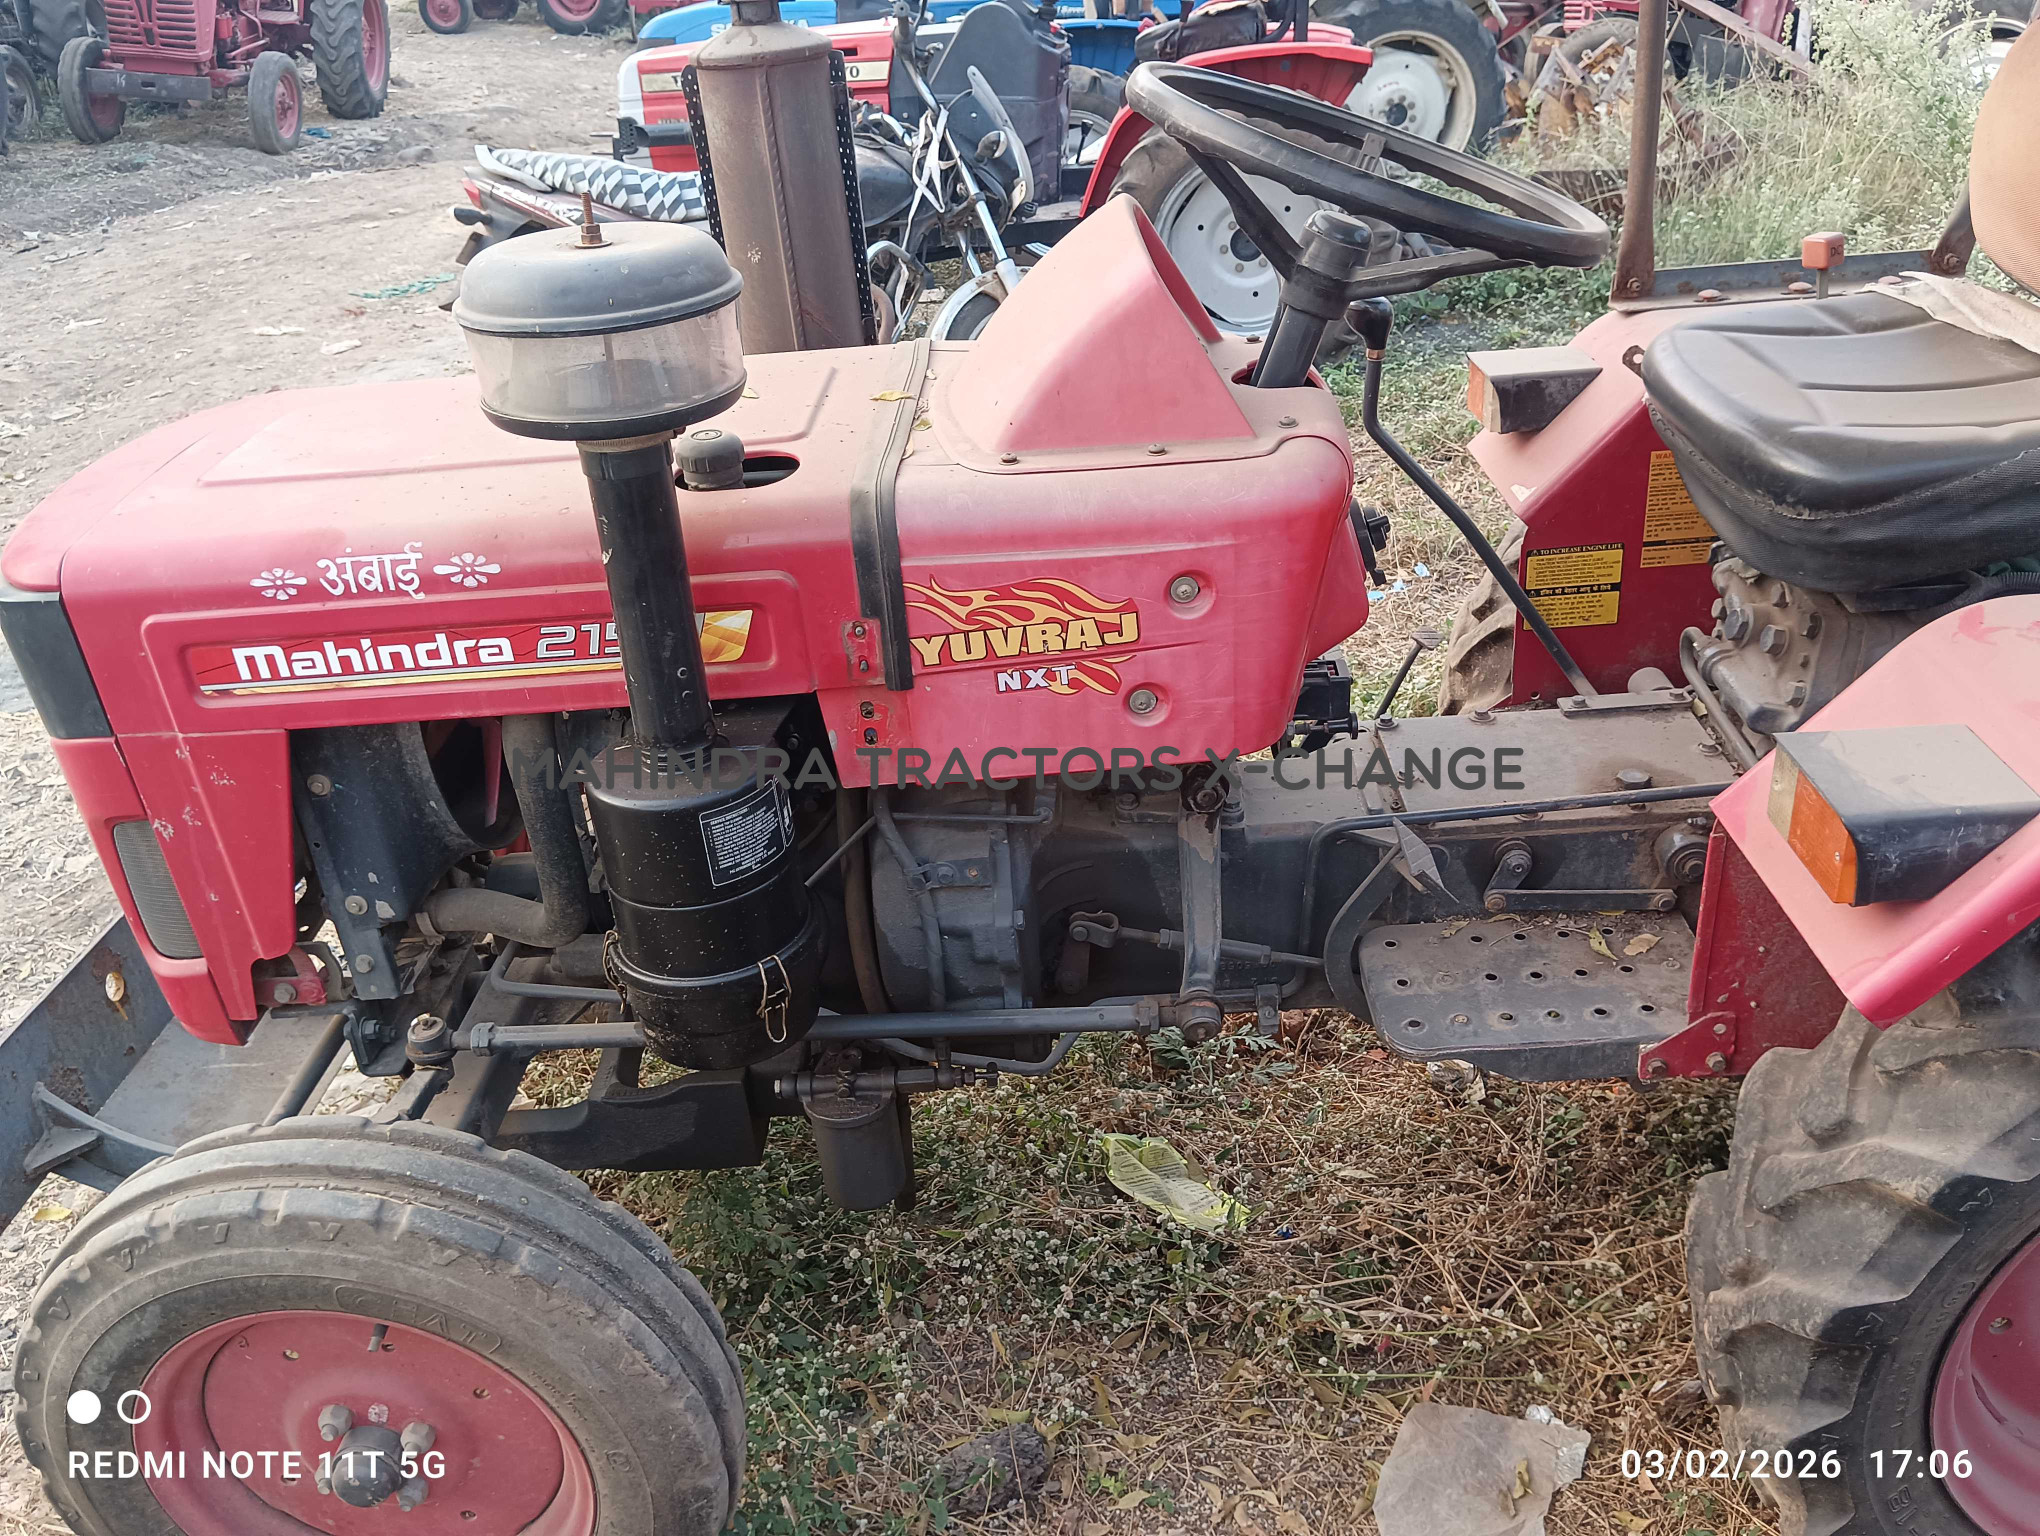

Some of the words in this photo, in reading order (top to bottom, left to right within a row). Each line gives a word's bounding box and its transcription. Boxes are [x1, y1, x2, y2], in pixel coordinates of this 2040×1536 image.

[316, 541, 426, 600] अंबाई
[1550, 546, 1582, 554] INCREASE
[1583, 544, 1607, 552] ENGINE
[231, 632, 515, 681] Mahindra
[910, 612, 1140, 667] YUVRAJ
[997, 664, 1076, 692] NXT
